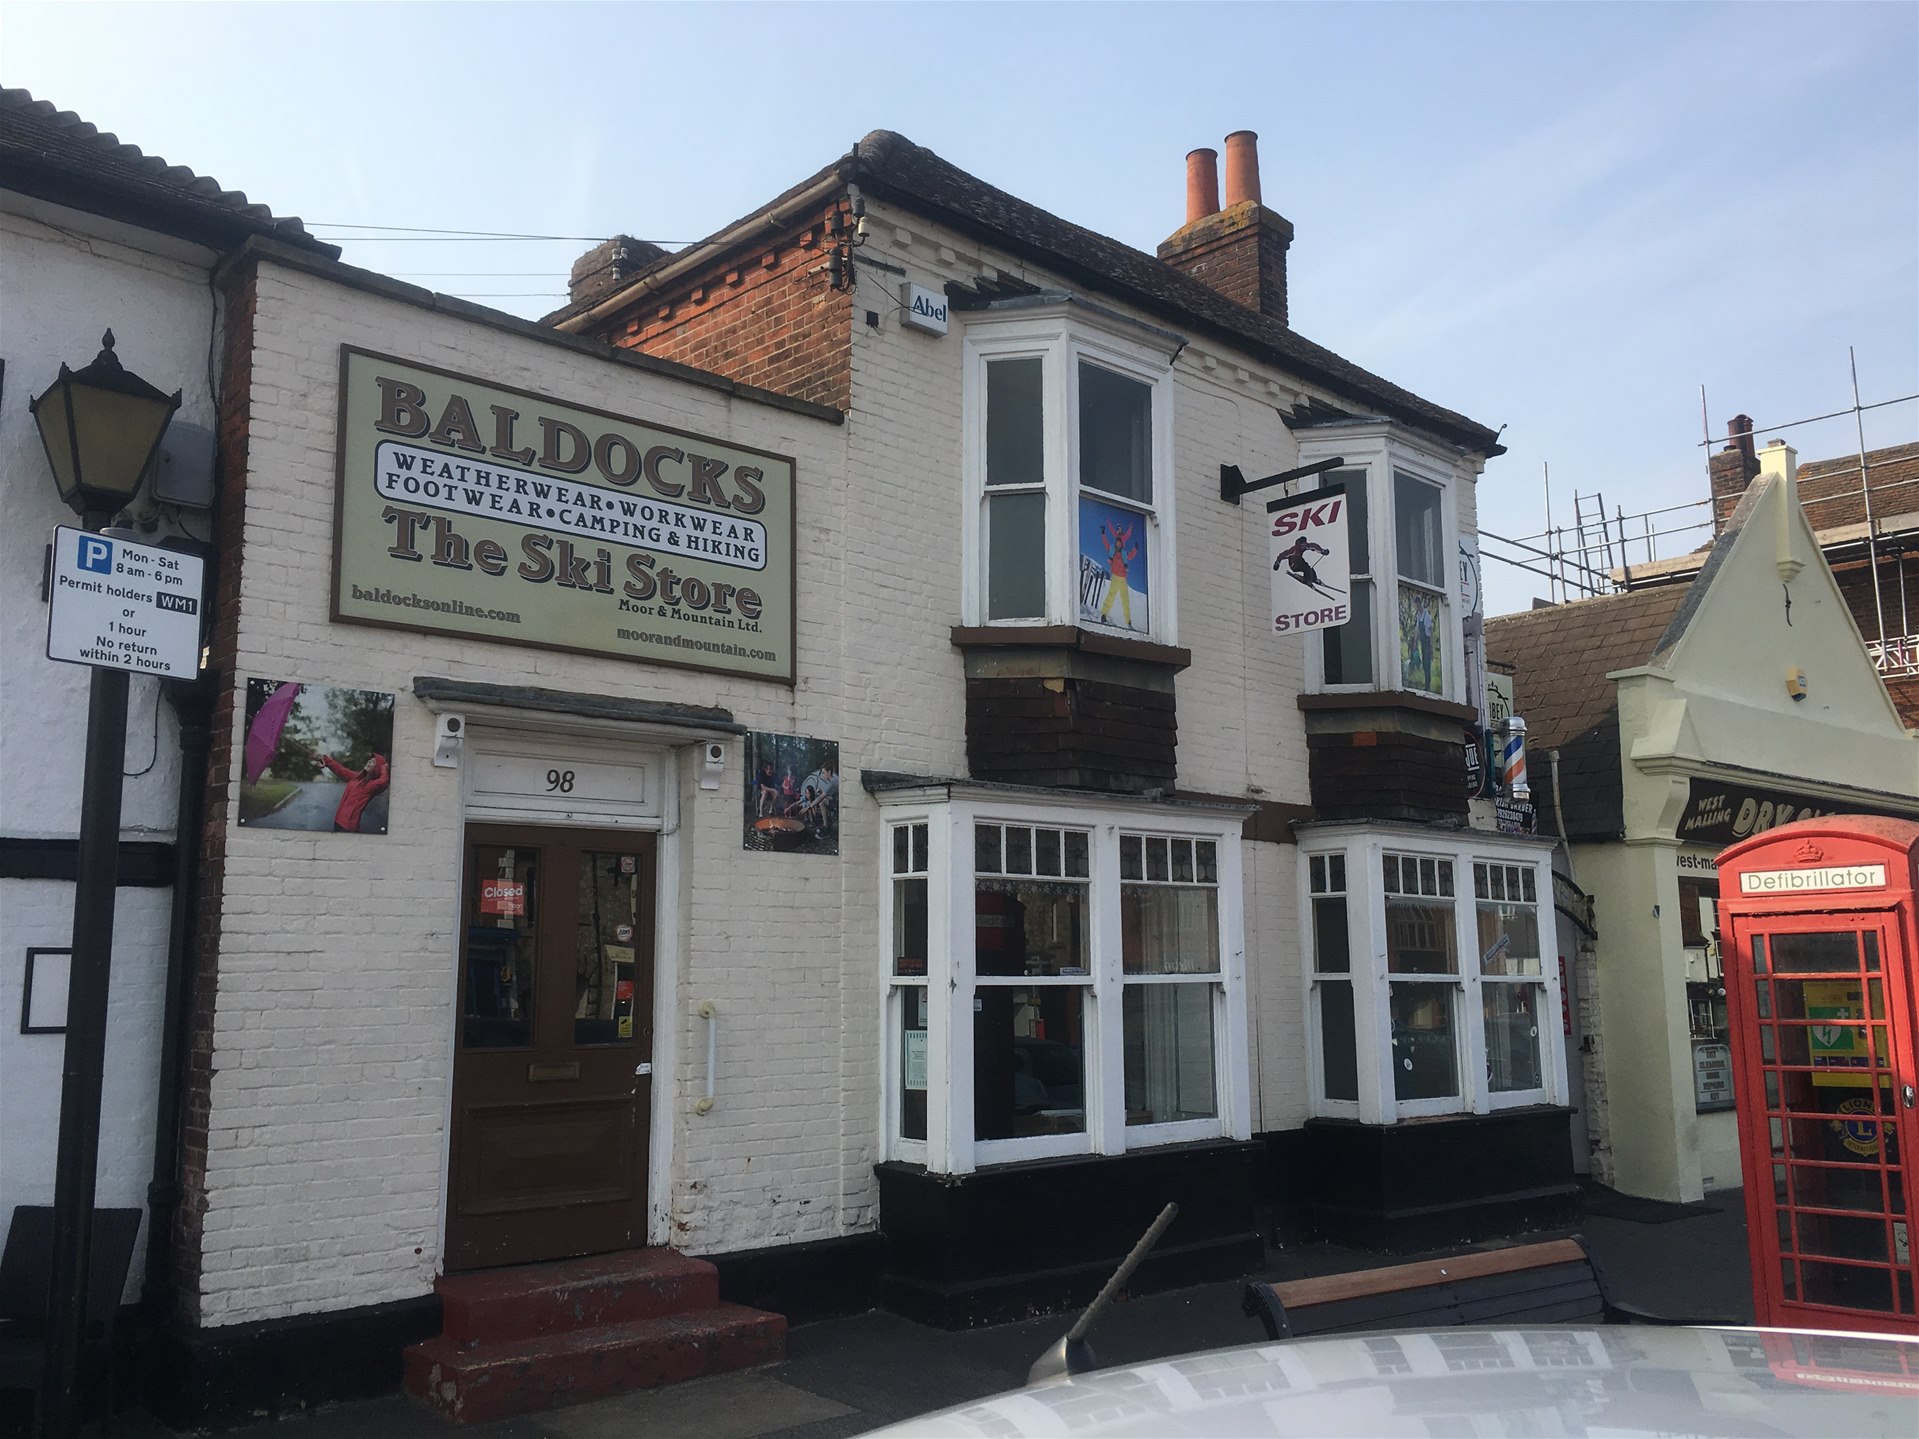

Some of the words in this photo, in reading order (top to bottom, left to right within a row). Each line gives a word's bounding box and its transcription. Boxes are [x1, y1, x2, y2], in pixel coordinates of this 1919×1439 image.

[912, 295, 947, 323] Abel
[373, 376, 766, 514] BALDOCKS
[393, 451, 603, 511] WEATHERWEAR
[619, 500, 756, 543] WORKWEAR
[385, 472, 542, 519] FOOTWEAR
[559, 508, 662, 543] CAMPING
[667, 531, 680, 547] &
[686, 534, 760, 563] HIKING
[1271, 500, 1342, 537] SKI
[86, 540, 108, 568] P
[122, 548, 149, 564] Mon
[158, 556, 180, 571] Sat
[381, 505, 508, 576] The
[517, 533, 614, 594] Ski
[622, 553, 764, 620] Store
[59, 575, 103, 593] Permit
[106, 584, 153, 603] holders
[161, 595, 193, 612] WM1
[351, 583, 522, 624] baldocksonline.com
[122, 608, 136, 618] or
[618, 599, 655, 616] Moor
[657, 605, 668, 618] &
[670, 607, 735, 629] Mountain
[737, 619, 763, 634] Ltd.
[1275, 604, 1347, 632] STORE
[109, 621, 114, 632] 1
[118, 622, 147, 637] hour
[96, 635, 114, 648] No
[118, 641, 158, 655] return
[616, 627, 777, 662] moorandmountain.com
[79, 648, 119, 663] within
[123, 654, 132, 664] 2
[136, 657, 171, 671] hours
[545, 768, 576, 793] 98
[1698, 794, 1726, 812] WEST
[1684, 807, 1732, 830] MALLING
[1732, 798, 1795, 838] DRY
[484, 885, 523, 898] Closed
[1748, 870, 1877, 890] Defibrillator
